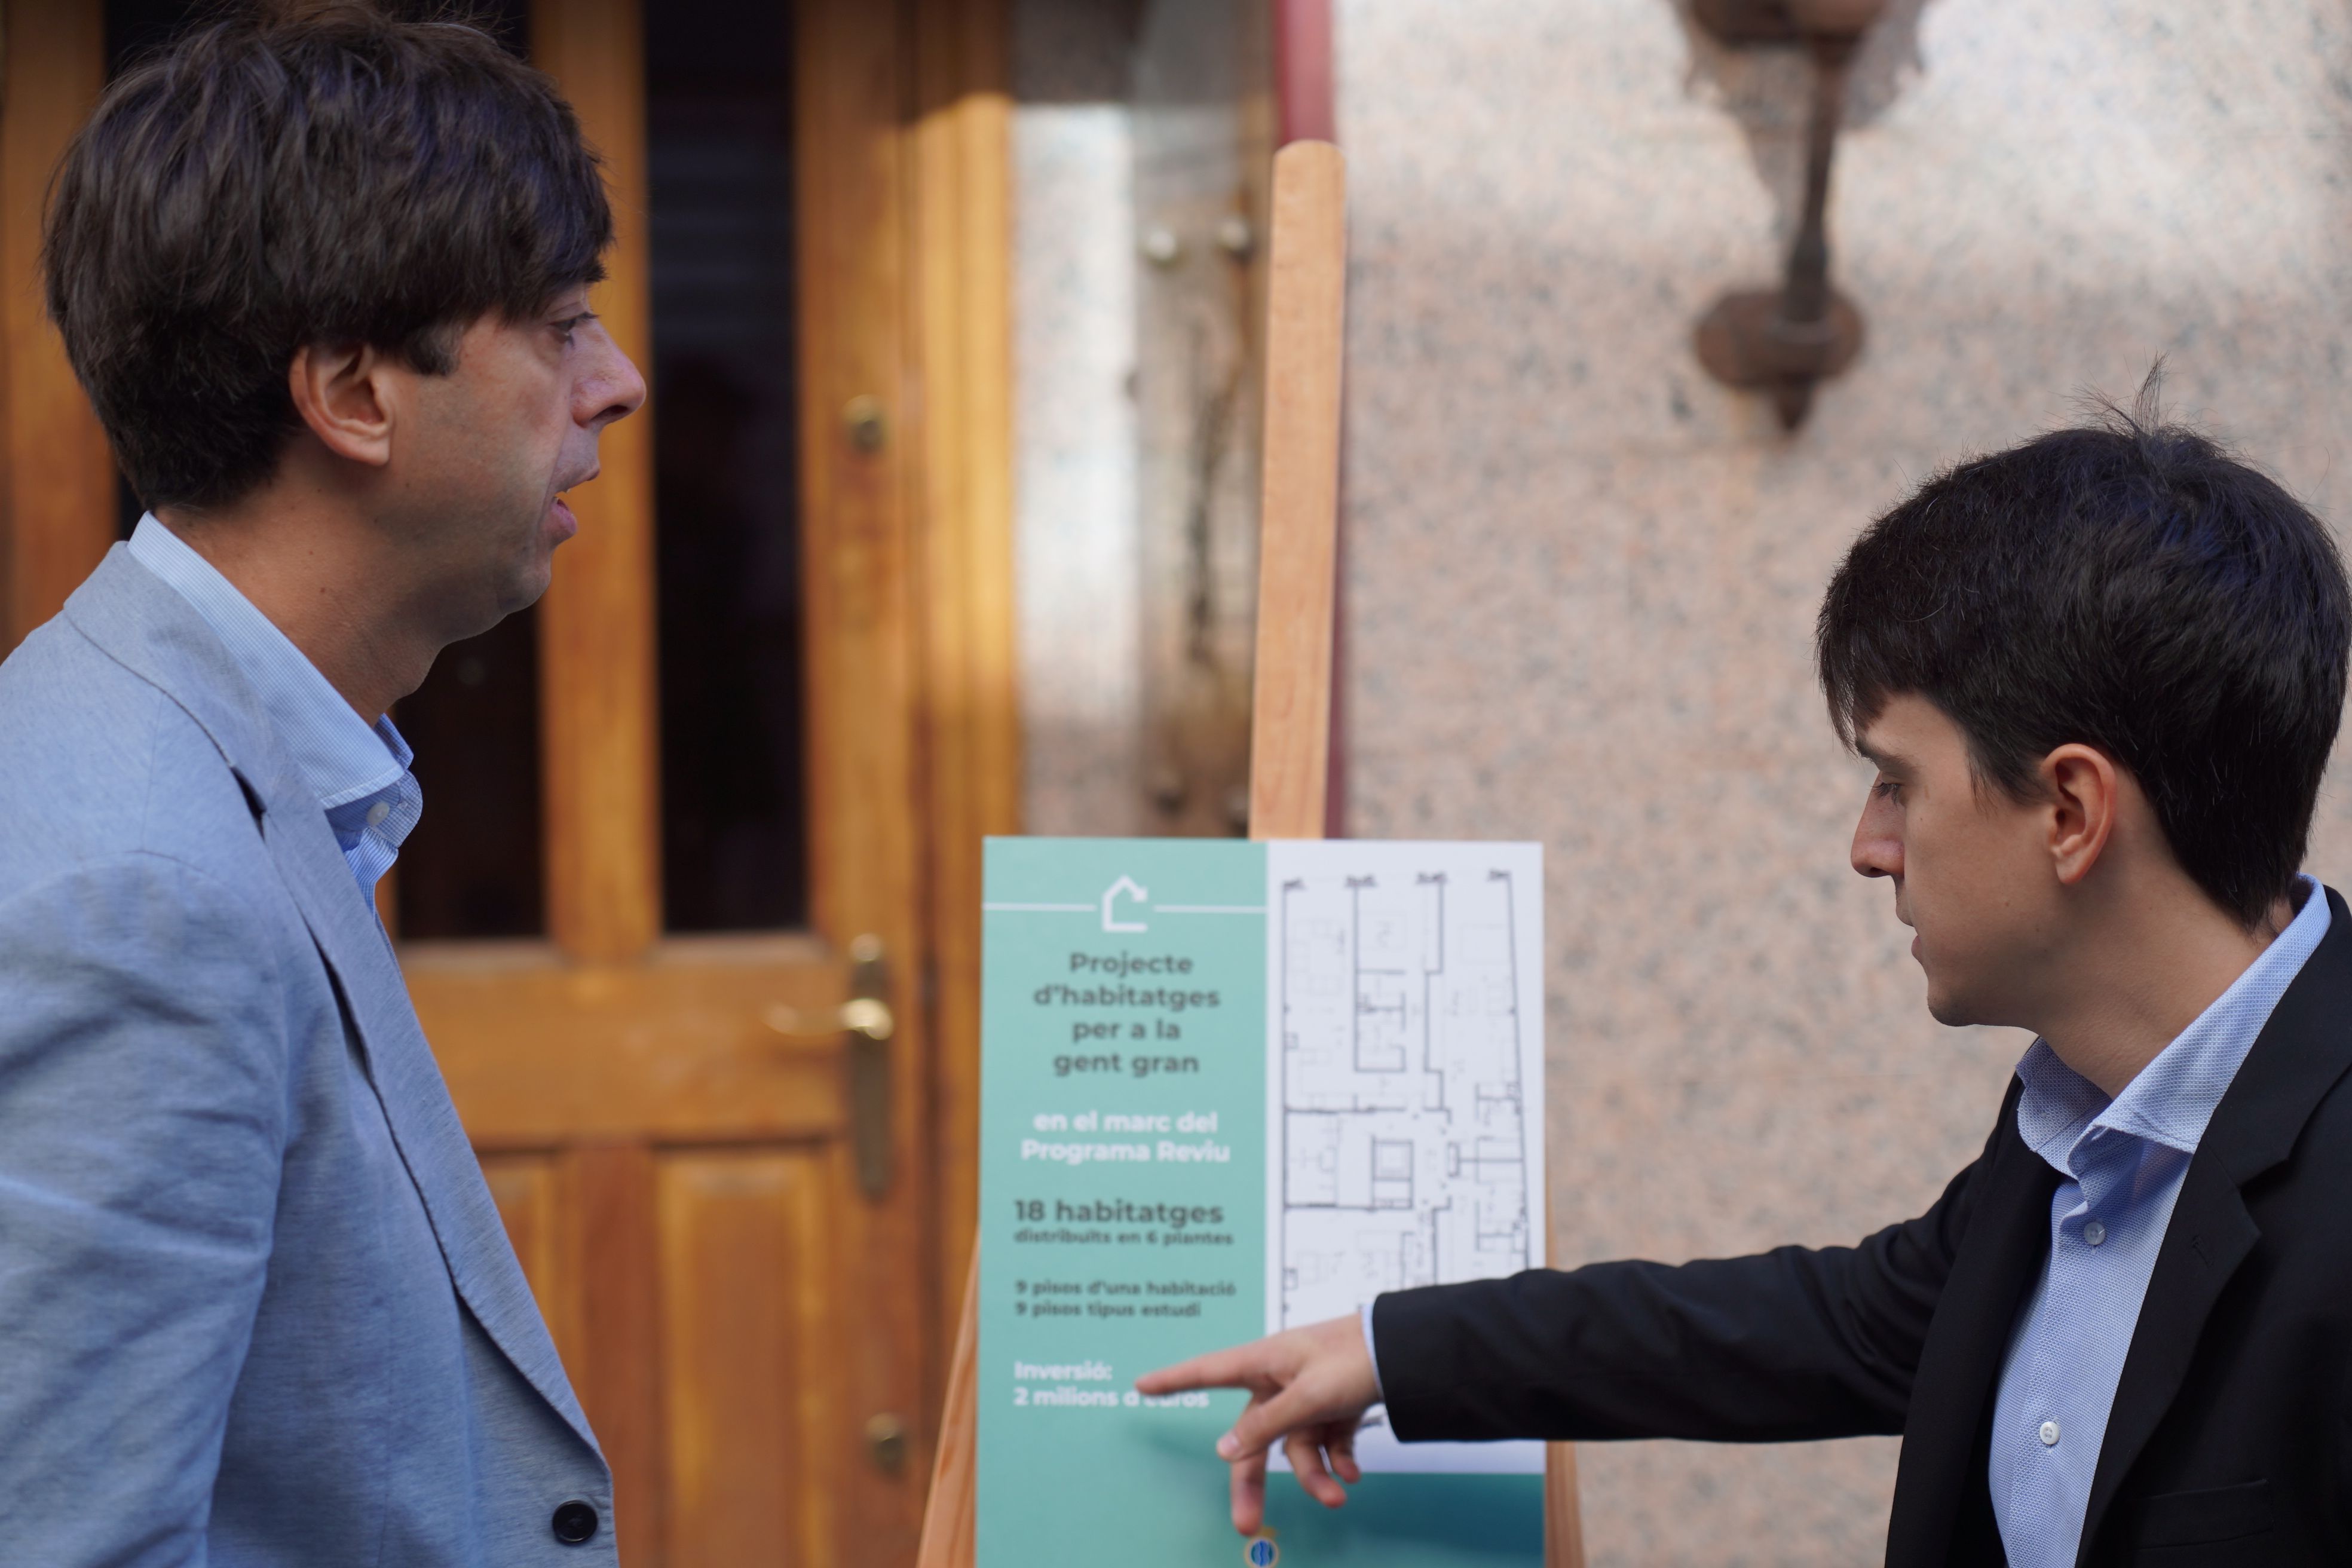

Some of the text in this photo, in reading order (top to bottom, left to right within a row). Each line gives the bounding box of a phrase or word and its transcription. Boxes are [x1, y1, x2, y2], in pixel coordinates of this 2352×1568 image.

[1068, 953, 1194, 980] Projecte
[1033, 984, 1220, 1011] d'habitatges
[1072, 1018, 1181, 1044] per a la
[1052, 1053, 1199, 1079] gent gran
[1033, 1110, 1217, 1133] en el marc del
[1021, 1140, 1230, 1165] Programa Reviu
[1015, 1199, 1223, 1227] 18 habitatges
[1117, 1233, 1141, 1244] en
[1146, 1231, 1157, 1244] 6
[1162, 1231, 1233, 1246] plantes
[1015, 1280, 1236, 1296] 9 pisos d'una habitació
[1015, 1301, 1200, 1319] 9 pisos tipus estudi
[1014, 1360, 1113, 1381] Inversió:
[1013, 1386, 1210, 1408] 2 milions deuros
